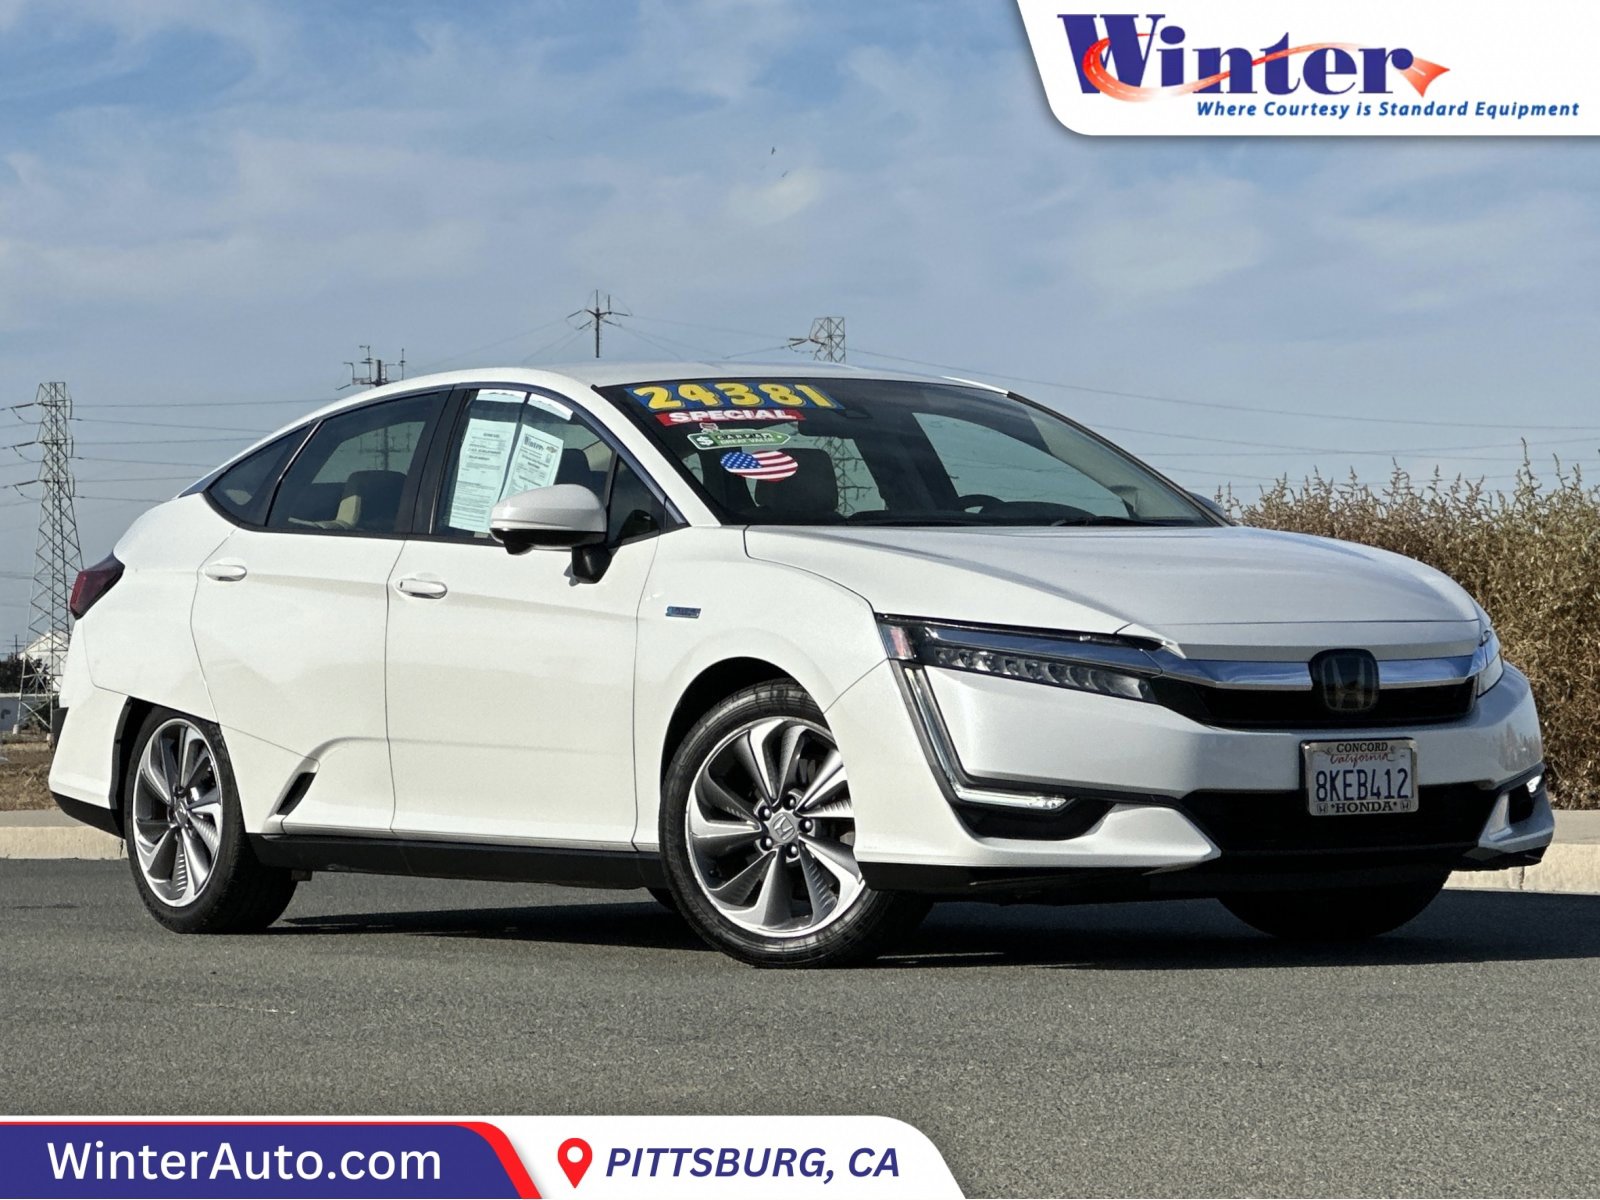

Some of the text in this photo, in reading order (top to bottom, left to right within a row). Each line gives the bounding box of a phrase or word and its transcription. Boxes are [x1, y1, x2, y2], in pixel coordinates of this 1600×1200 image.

[633, 382, 836, 410] 24381
[668, 409, 797, 424] SPECIAL
[1336, 742, 1389, 753] CONCORD
[1330, 753, 1391, 768] California
[1315, 768, 1410, 802] 8KEB412
[1336, 801, 1393, 813] HONDA
